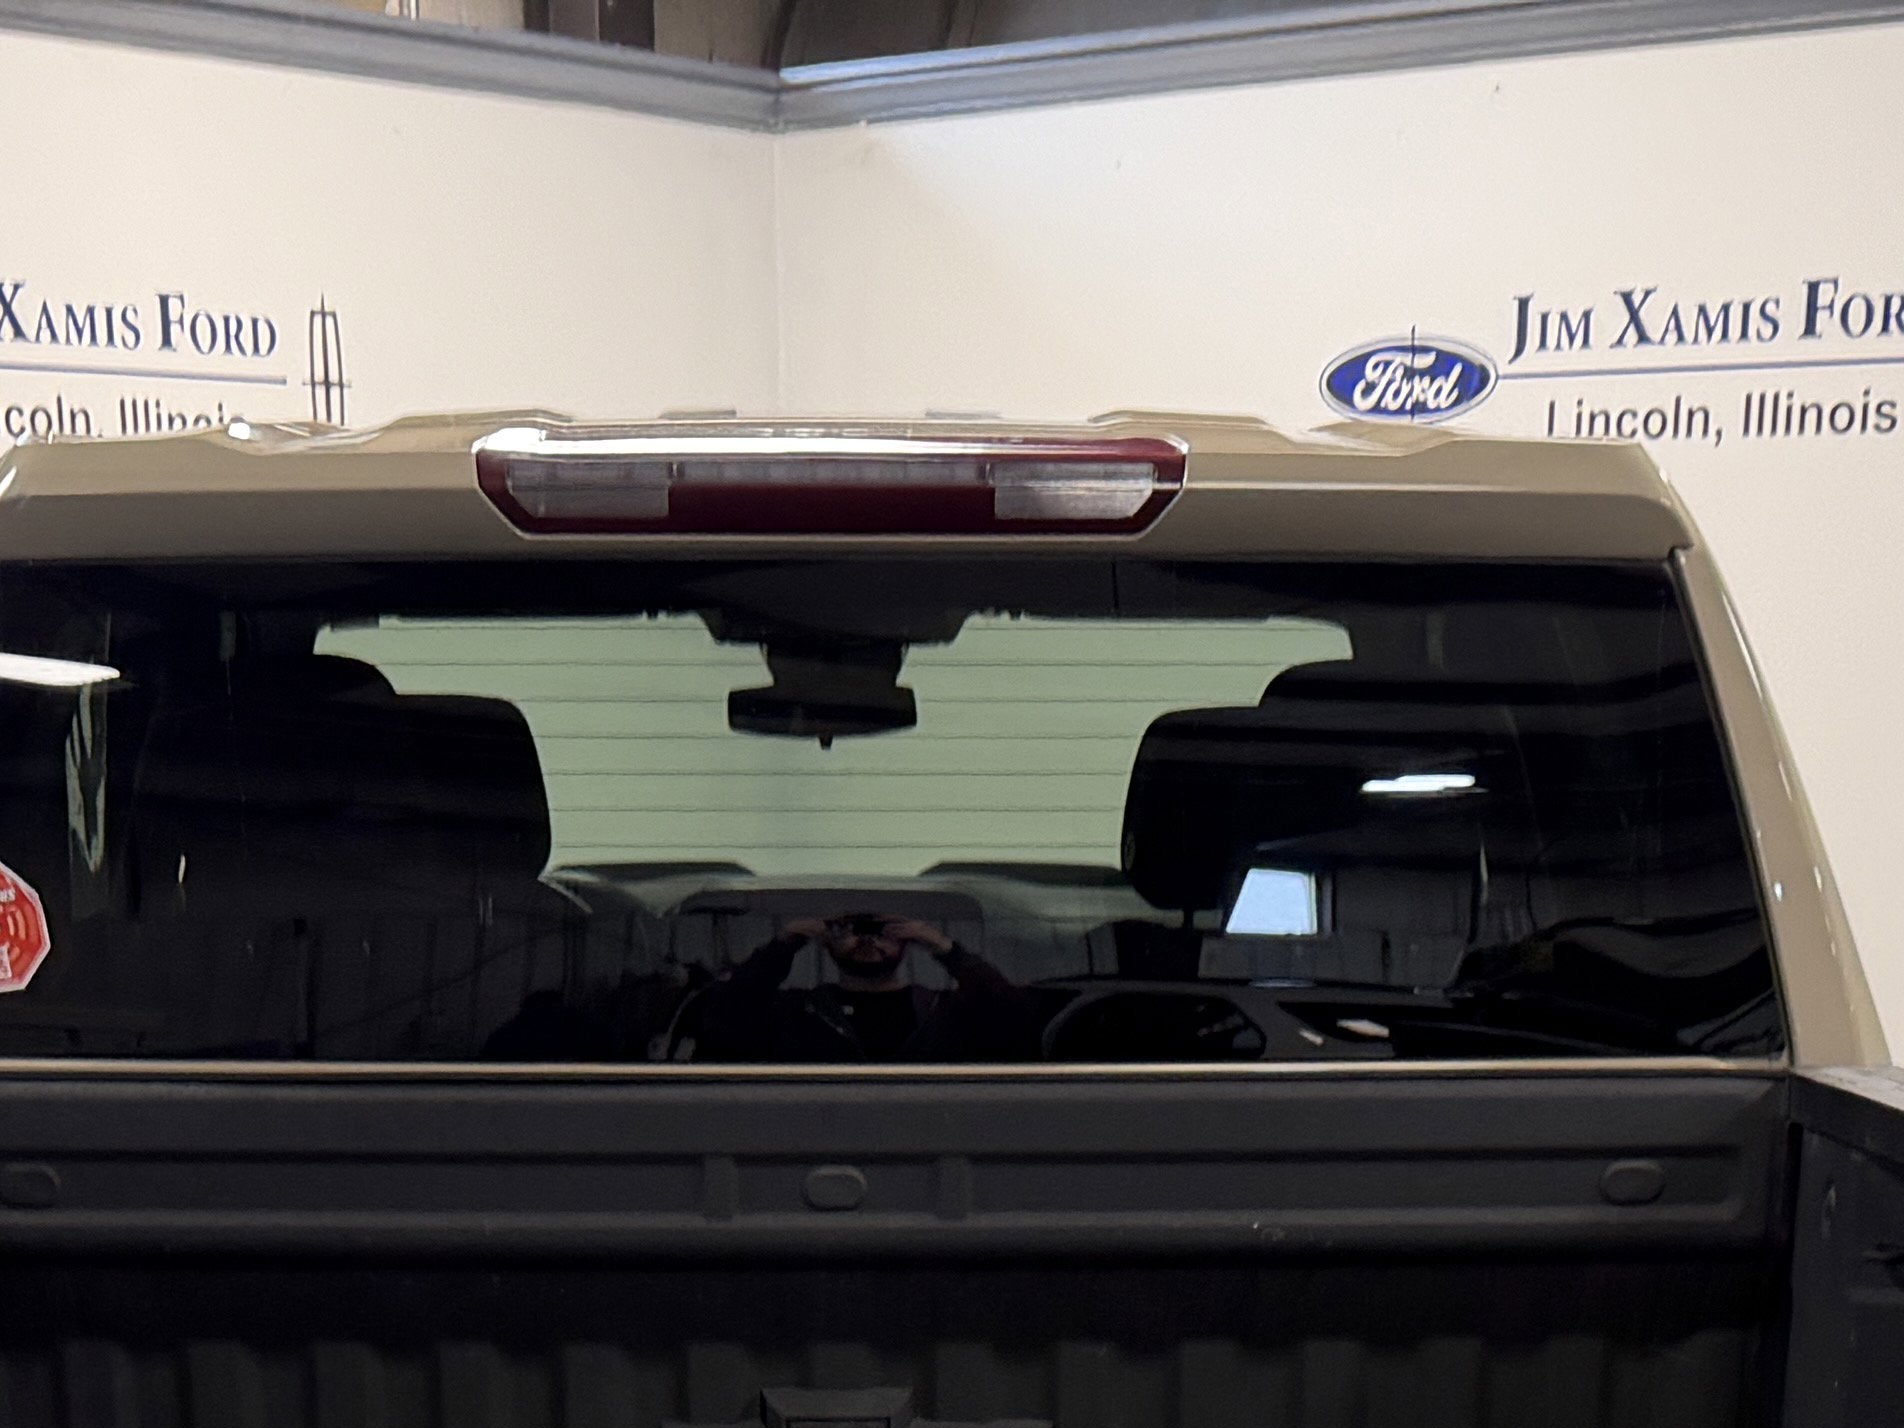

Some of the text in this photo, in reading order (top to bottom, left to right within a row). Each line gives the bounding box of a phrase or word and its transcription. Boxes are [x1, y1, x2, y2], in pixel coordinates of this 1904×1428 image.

[156, 291, 278, 358] FORD
[1507, 292, 1594, 365] JIM
[1609, 285, 1781, 349] XAMIS
[1352, 351, 1463, 411] Ford
[119, 395, 246, 436] Illinoi
[1741, 387, 1898, 439] Illinois
